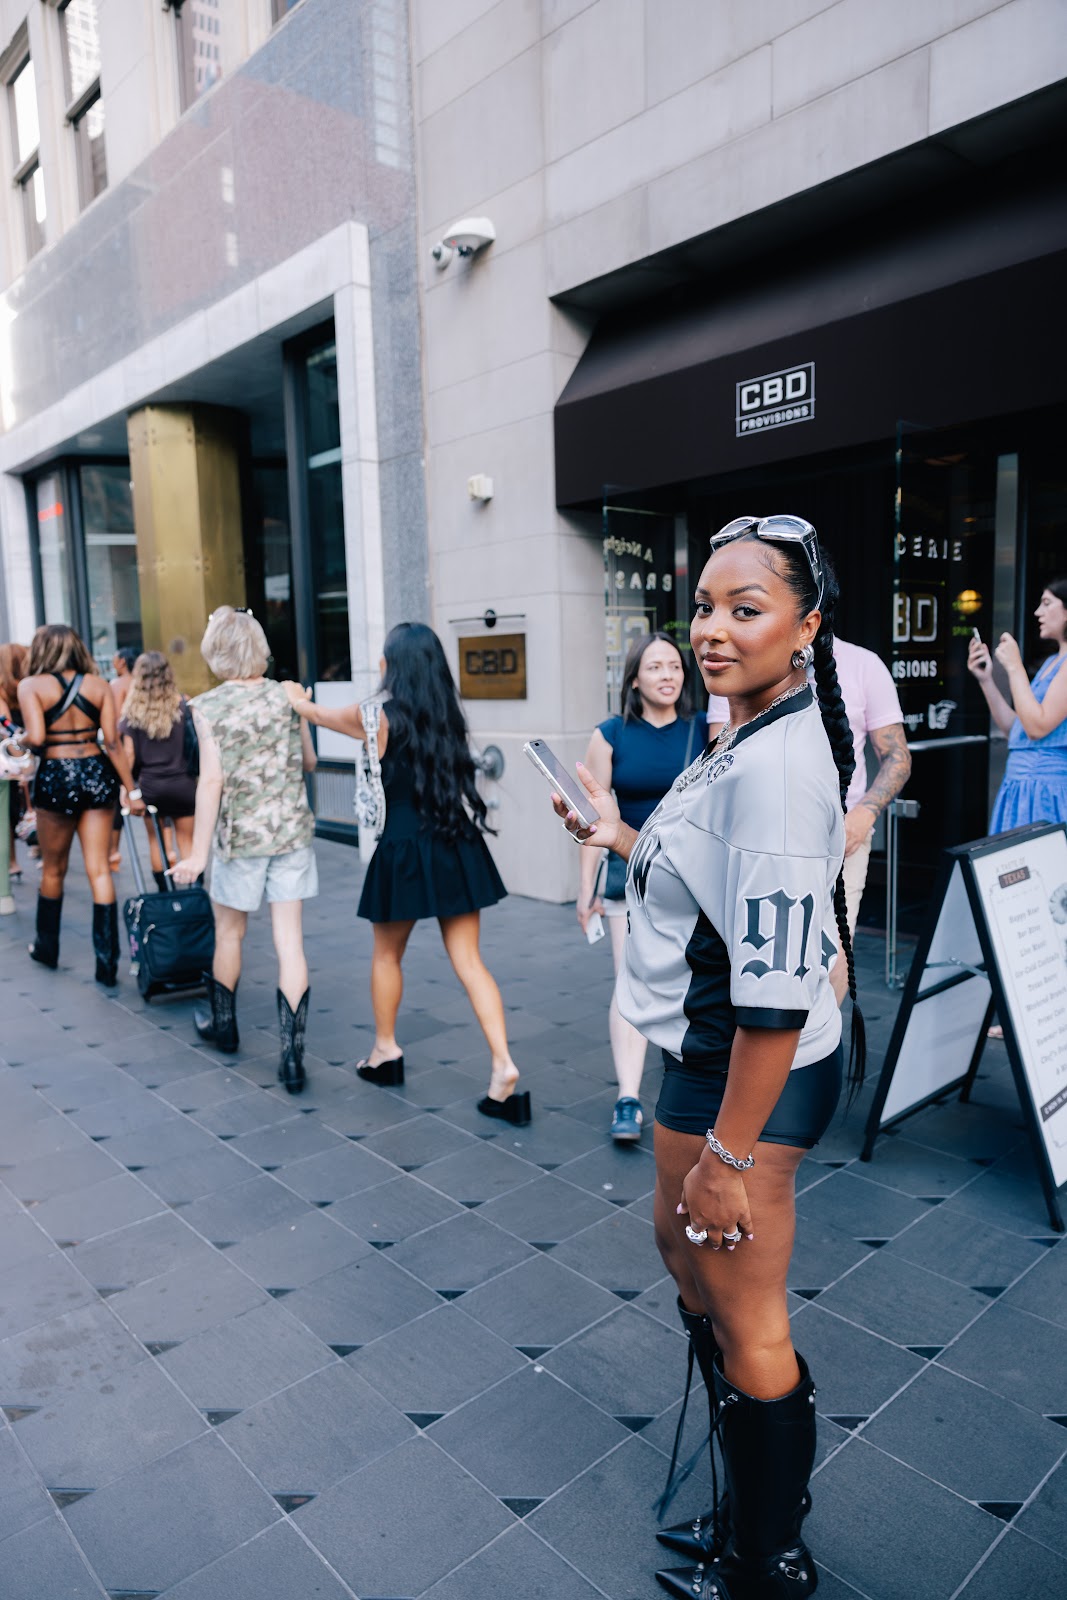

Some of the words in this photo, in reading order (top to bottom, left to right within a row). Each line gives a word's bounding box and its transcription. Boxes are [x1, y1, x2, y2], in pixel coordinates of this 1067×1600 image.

[741, 370, 807, 411] CBD
[741, 405, 809, 431] PROVISIONS
[893, 592, 937, 642] BD
[465, 648, 518, 675] CBD
[1003, 869, 1026, 885] TEXAS
